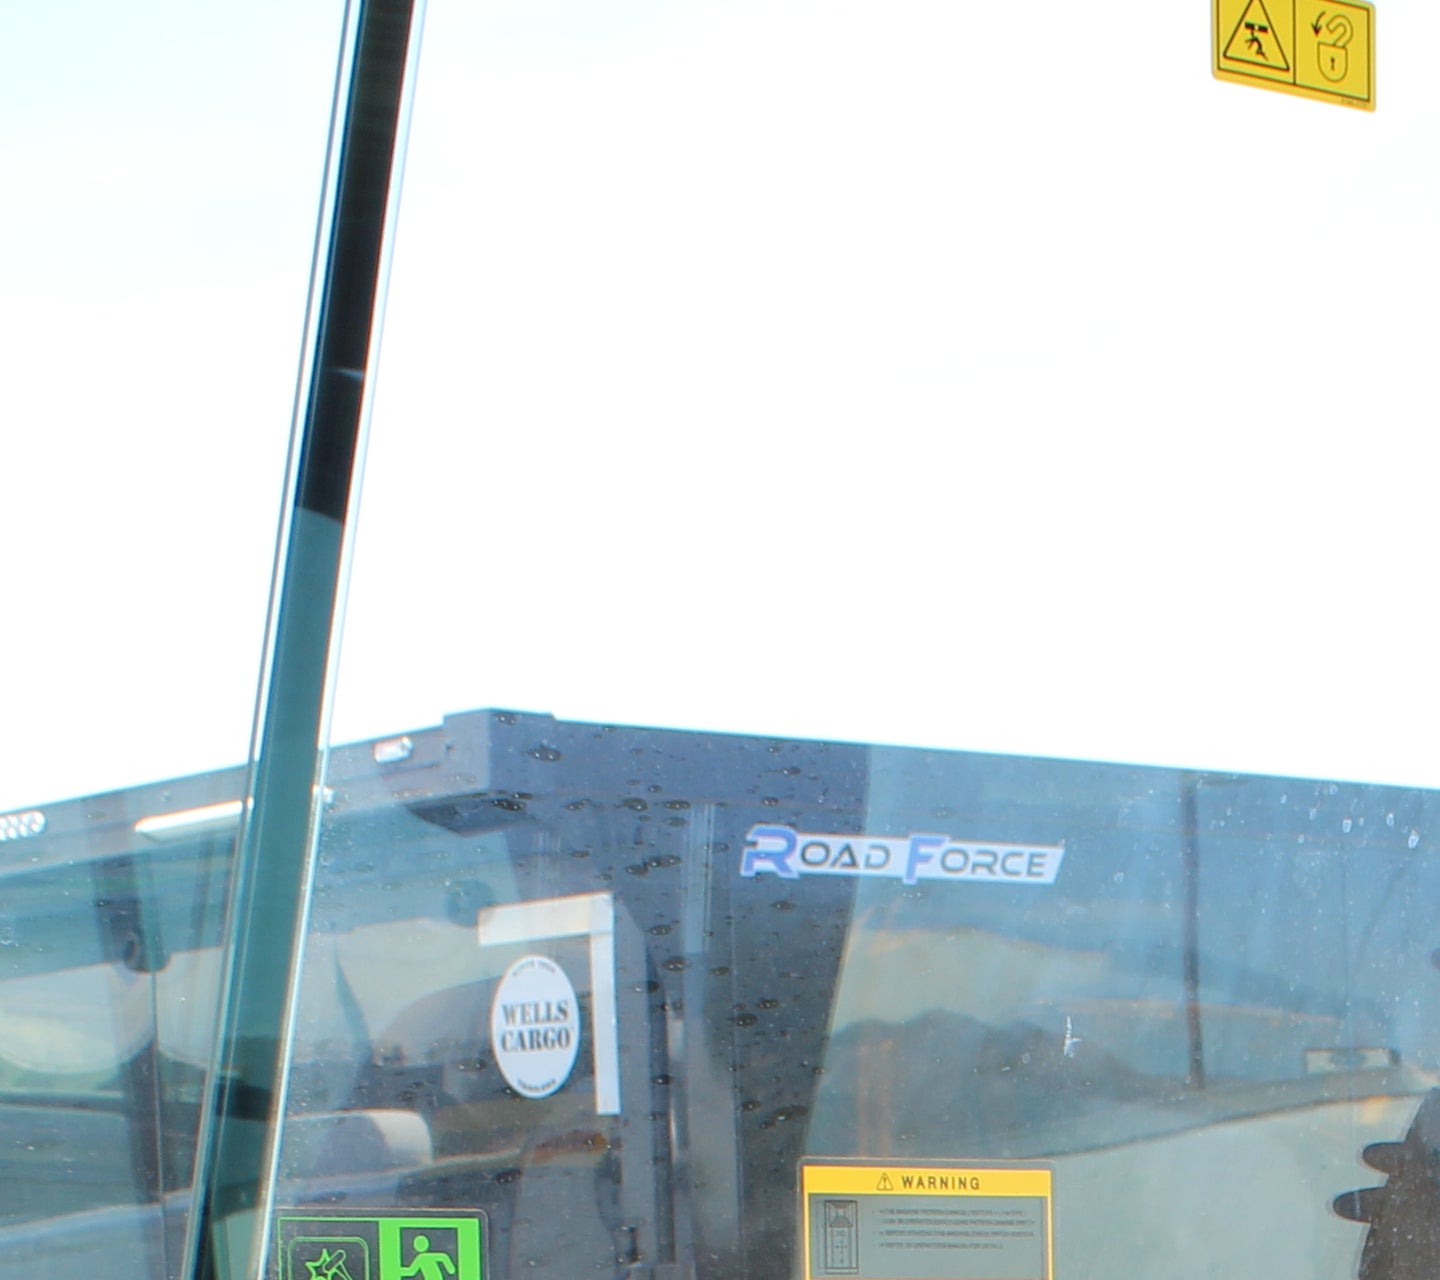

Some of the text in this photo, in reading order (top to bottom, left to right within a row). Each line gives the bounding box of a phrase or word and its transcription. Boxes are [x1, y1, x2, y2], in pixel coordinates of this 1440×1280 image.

[500, 1001, 569, 1027] WELLS
[500, 1027, 571, 1052] CARGO
[901, 1174, 980, 1191] WARNING
